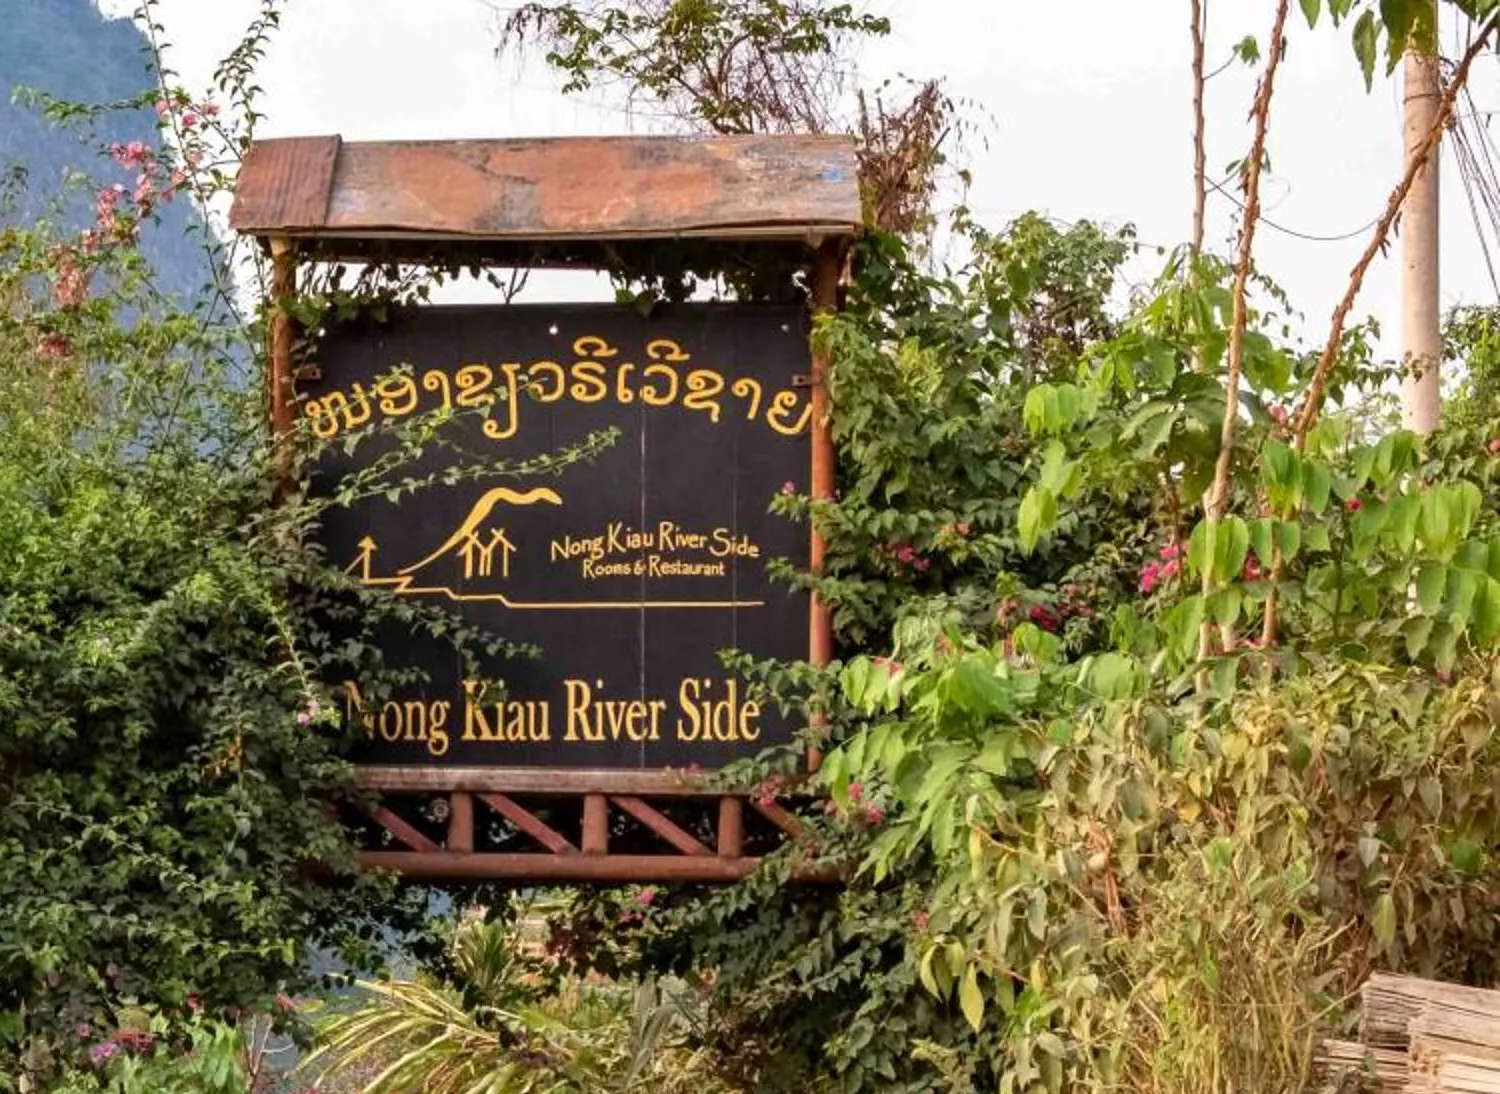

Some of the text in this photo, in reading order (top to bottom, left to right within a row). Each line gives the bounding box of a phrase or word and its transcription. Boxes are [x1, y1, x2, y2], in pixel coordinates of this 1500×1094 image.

[550, 520, 760, 561] Nong Kiau River Side
[582, 554, 726, 579] Rooms & Restaurant
[461, 678, 552, 742] Kiau
[563, 677, 668, 742] River
[677, 677, 762, 742] Side
